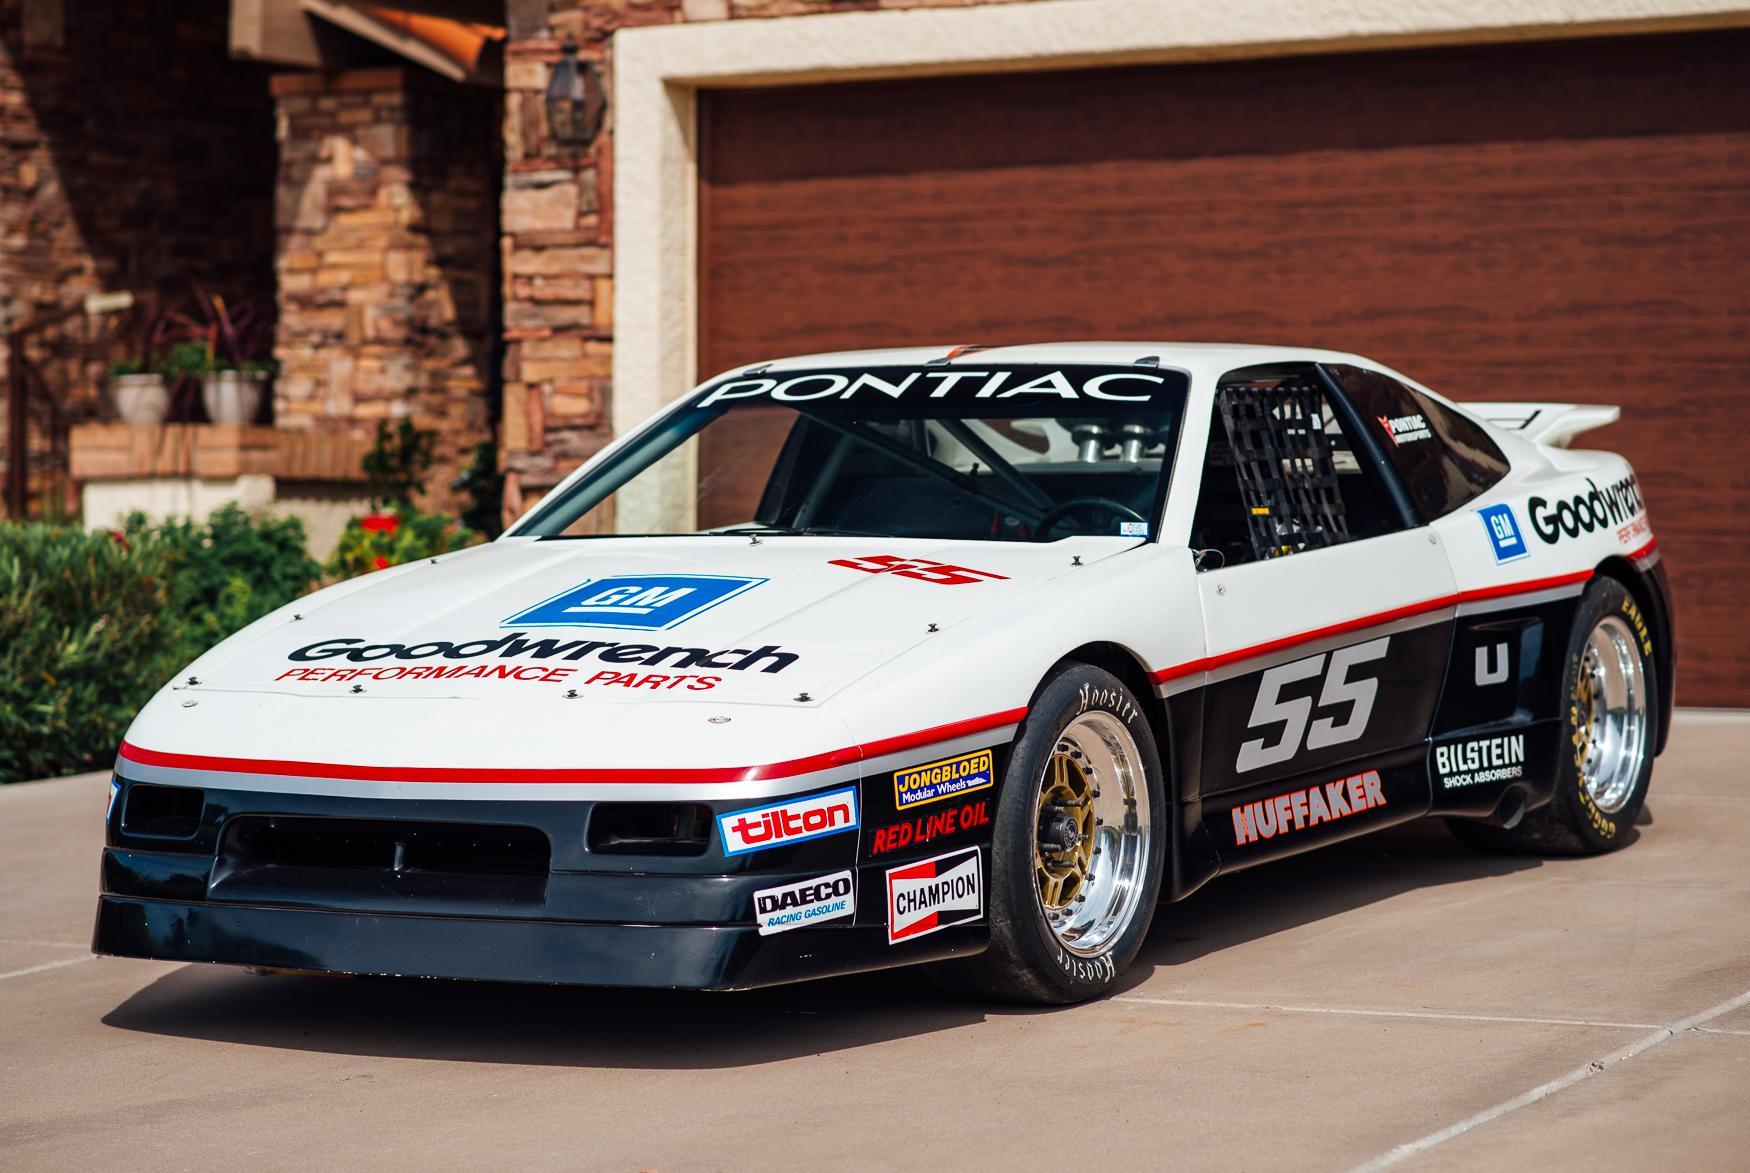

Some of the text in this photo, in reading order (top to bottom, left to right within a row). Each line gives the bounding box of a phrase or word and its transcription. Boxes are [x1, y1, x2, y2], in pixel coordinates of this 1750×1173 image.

[697, 371, 1164, 408] PONTIAC
[1388, 414, 1426, 433] PONTIAC
[1490, 513, 1515, 540] GM
[827, 555, 1011, 585] 55
[580, 585, 698, 609] GM
[1621, 594, 1653, 657] EAGLE
[287, 632, 800, 674] Goodwrench
[274, 664, 722, 691] PERFORMANCE PARTS
[1076, 683, 1138, 724] Hoosier
[1236, 636, 1391, 774] 55
[1436, 734, 1524, 775] BILSTEIN
[899, 756, 989, 793] JONGBLOED
[902, 779, 967, 805] Modular Wheels
[1443, 766, 1523, 789] SHOCK ABSORBERS
[731, 803, 850, 845] tilton
[1231, 769, 1388, 846] HUFFAKER
[872, 821, 913, 855] RED
[960, 801, 991, 830] OIL
[757, 878, 851, 915] DAECO
[896, 873, 977, 916] CHAMPION
[767, 900, 847, 928] RACING GASOLINE
[1057, 948, 1117, 983] Hoosier
